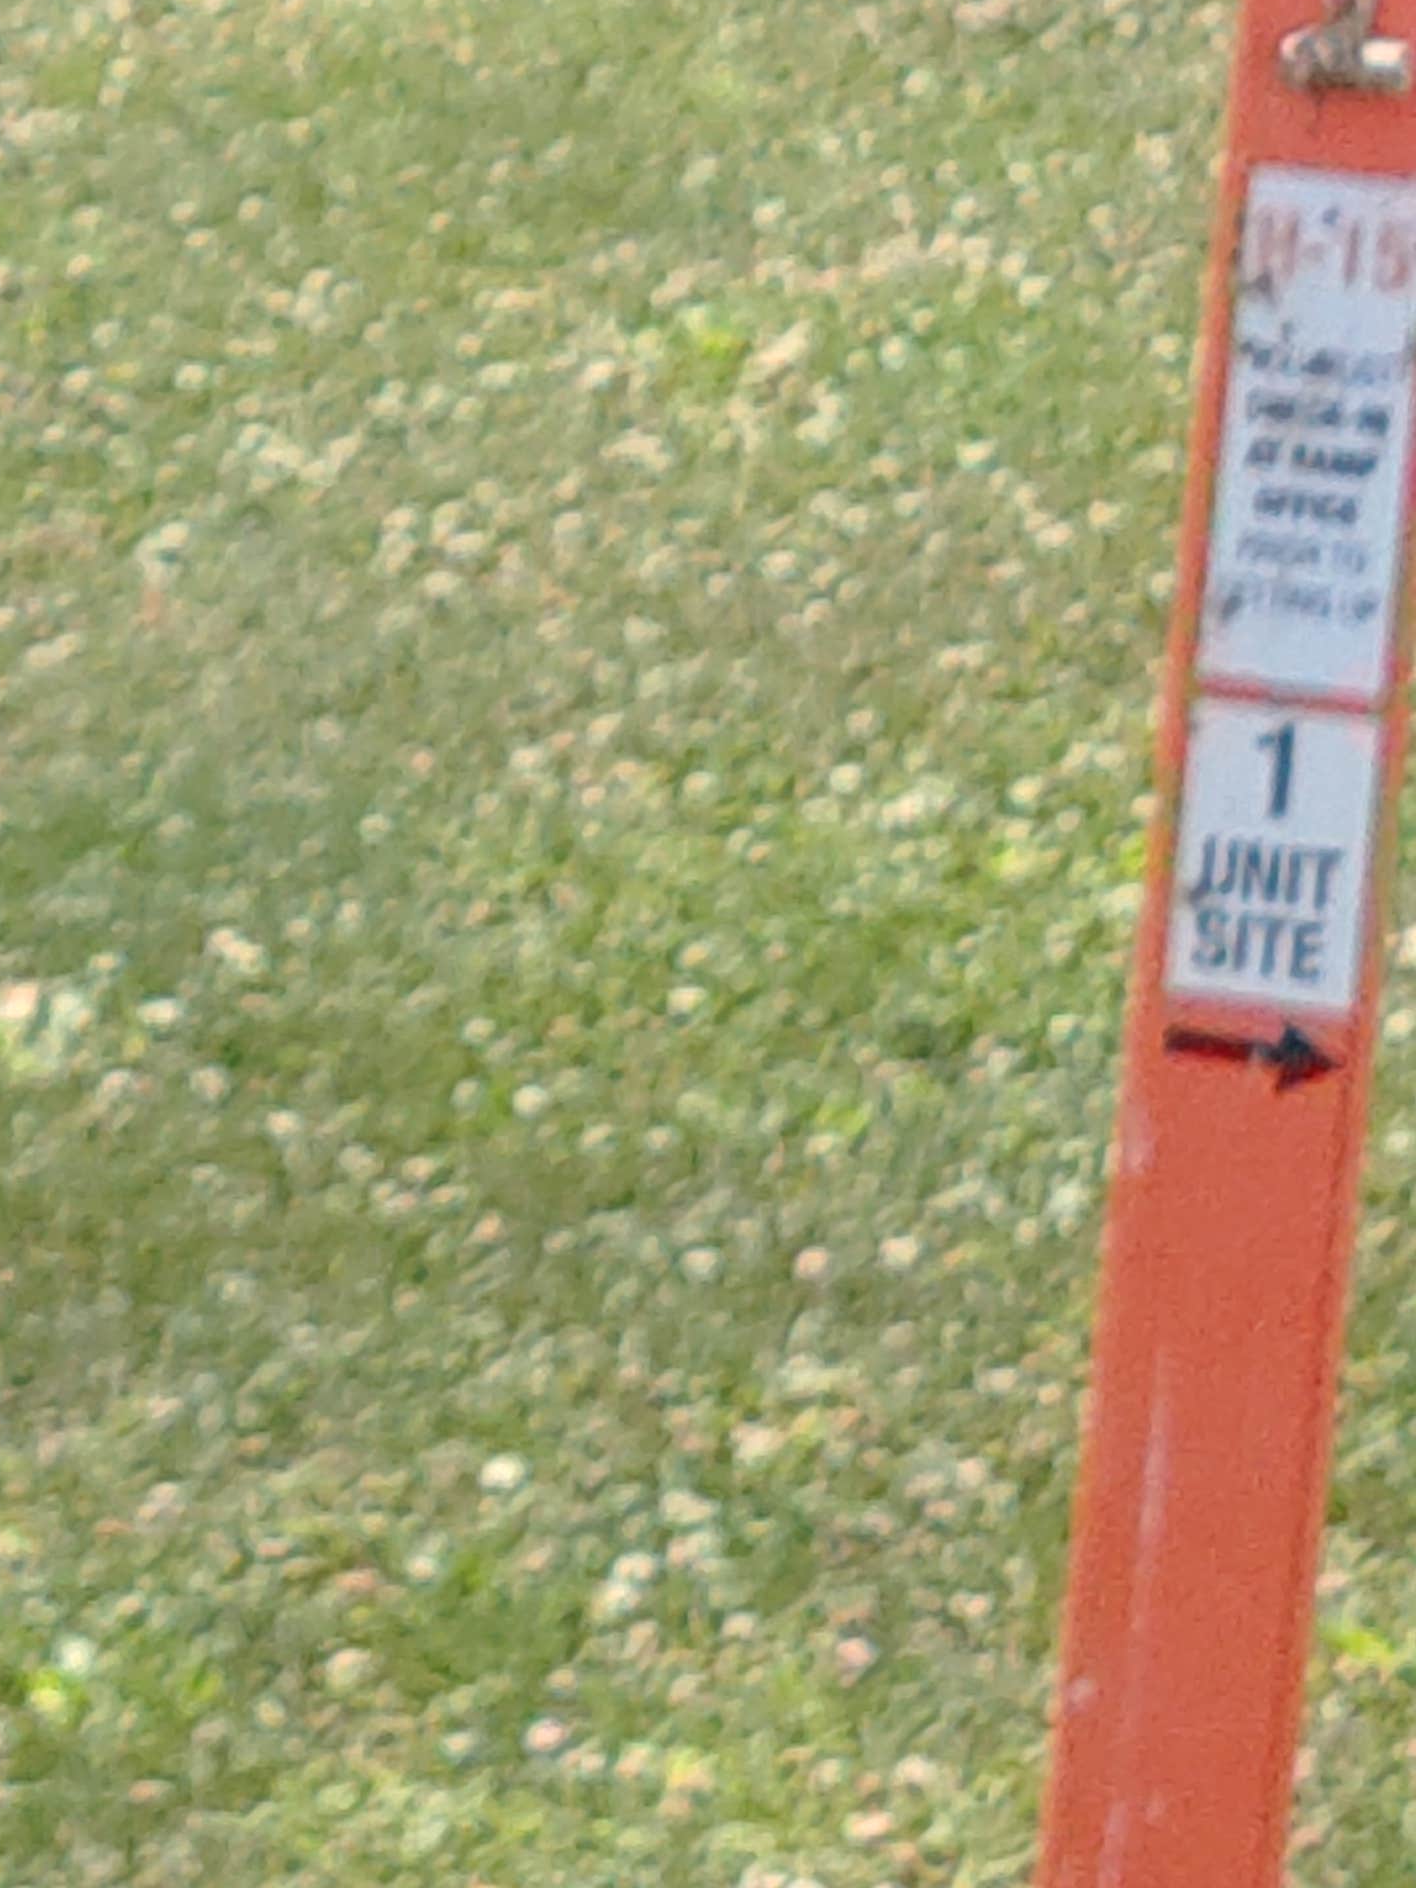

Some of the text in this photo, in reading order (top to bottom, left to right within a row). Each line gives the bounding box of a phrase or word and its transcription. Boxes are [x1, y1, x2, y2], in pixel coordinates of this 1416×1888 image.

[1254, 720, 1296, 818] 1
[1194, 832, 1344, 910] UNIT
[1188, 906, 1326, 984] SITE
